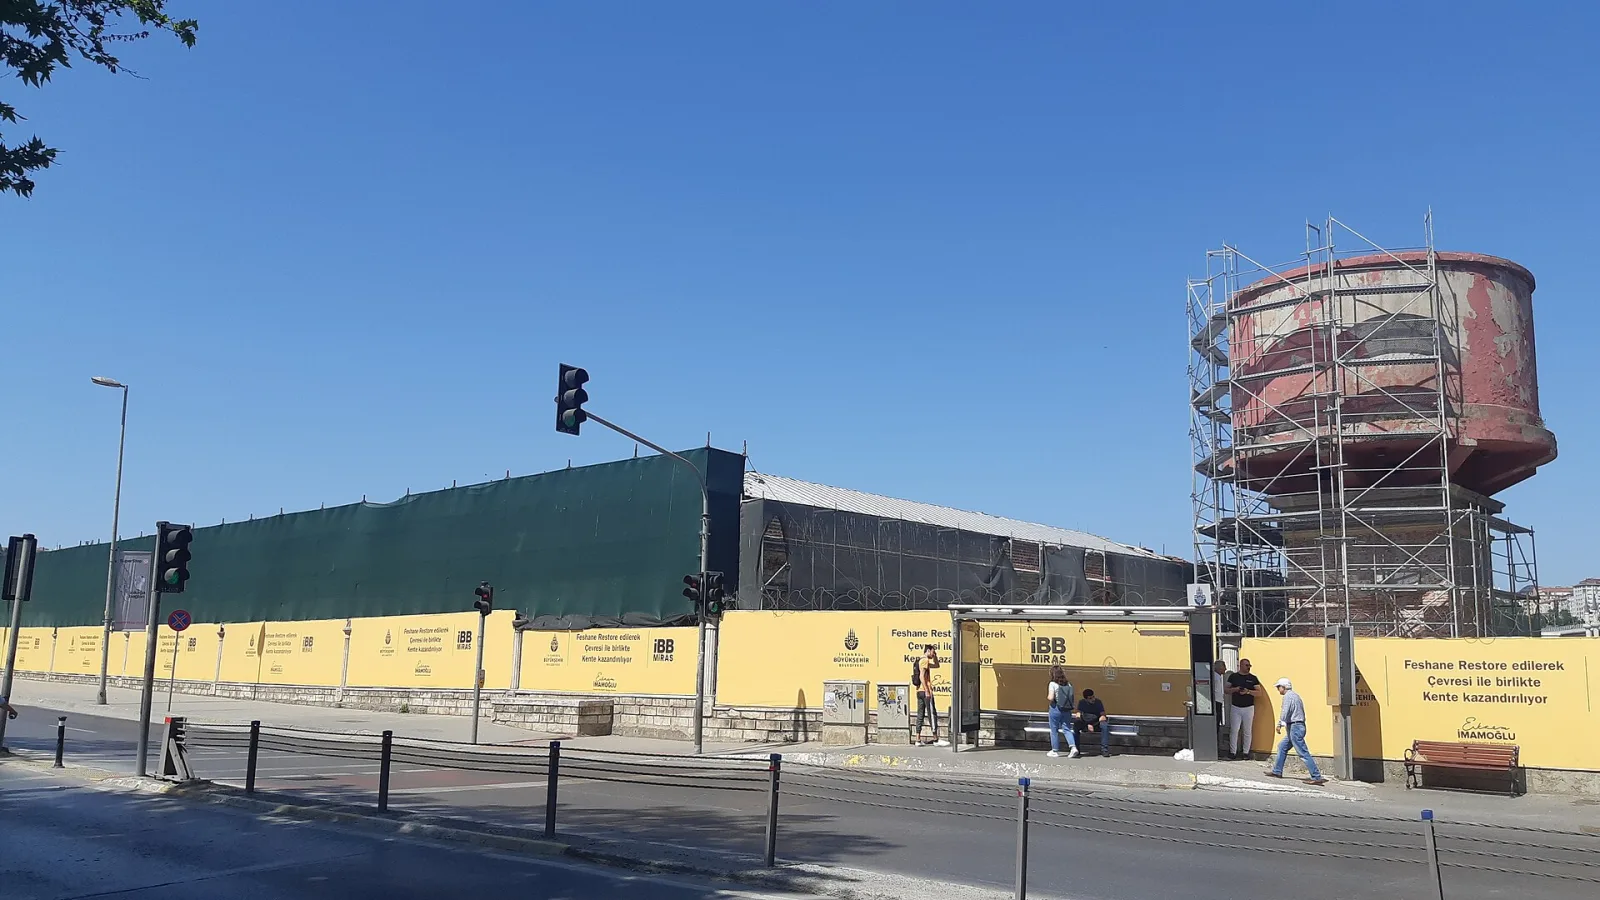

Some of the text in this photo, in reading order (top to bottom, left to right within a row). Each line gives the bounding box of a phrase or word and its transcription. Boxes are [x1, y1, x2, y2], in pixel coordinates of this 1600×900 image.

[576, 633, 641, 641] Feshane Restore edilerek
[891, 629, 928, 638] Feshane
[931, 629, 952, 638] Rest
[584, 644, 604, 652] Çevresi
[611, 644, 631, 652] birlikte
[903, 654, 921, 663] Ken
[1404, 659, 1565, 671] Feshane Restore edilerek
[1427, 675, 1541, 688] Çevresi ile birlikte
[1423, 691, 1548, 706] Kente kazandırılıyor
[1457, 728, 1516, 741] İMAMOĞLU
